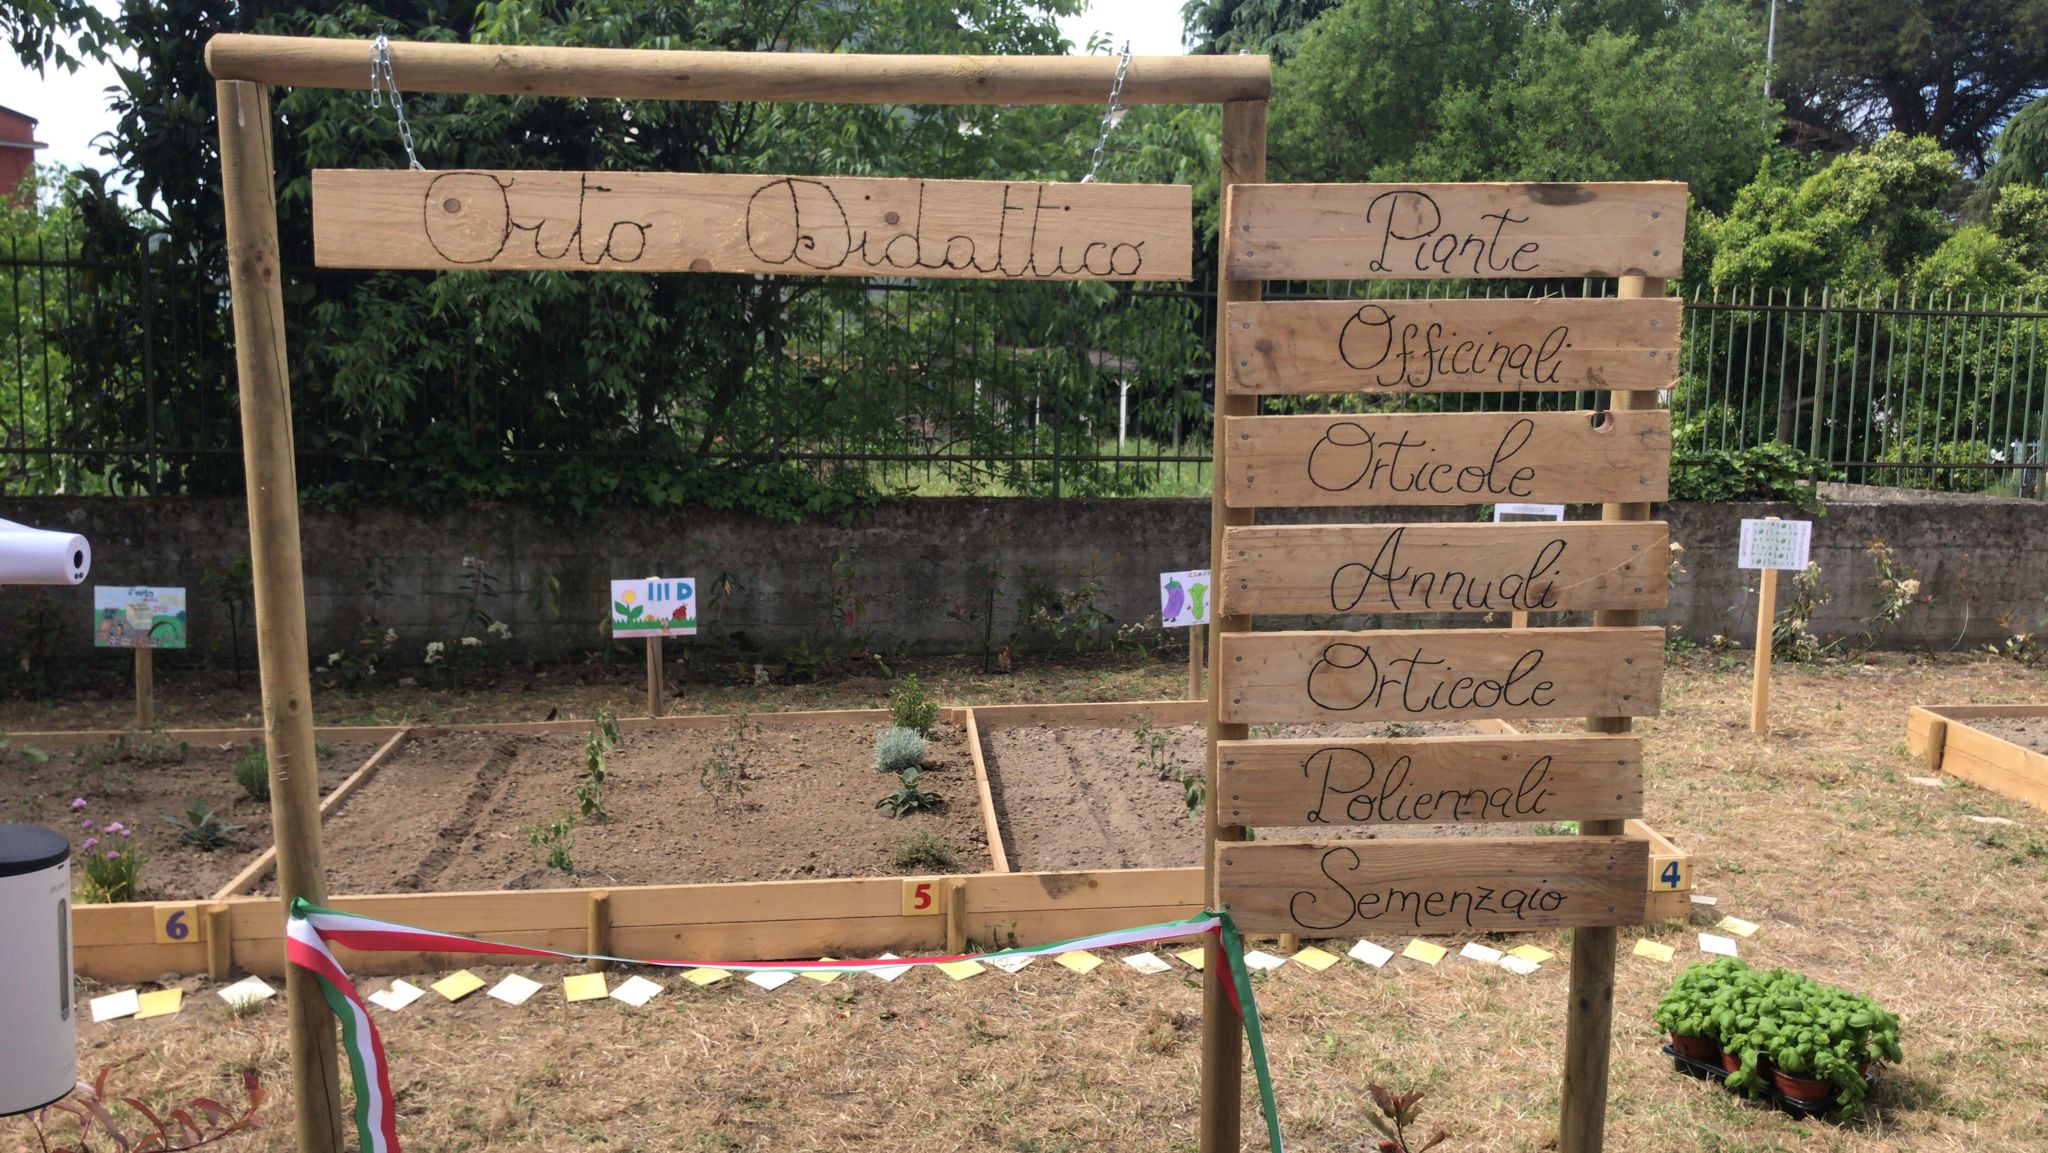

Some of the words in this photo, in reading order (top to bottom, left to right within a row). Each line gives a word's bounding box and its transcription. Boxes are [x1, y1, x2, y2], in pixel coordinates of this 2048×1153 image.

[424, 172, 652, 264] Orto
[746, 178, 1145, 277] Didattico
[1367, 191, 1539, 274] Piante
[1339, 304, 1572, 387] Officinali
[1307, 418, 1536, 497] Orticole
[677, 583, 692, 600] D
[1330, 527, 1567, 611] Annuali
[1307, 642, 1556, 712] Orticole
[1304, 747, 1554, 823] Poliennali
[915, 883, 931, 909] 5
[1289, 847, 1568, 930] Semenzaio
[1661, 861, 1680, 888] 4
[166, 910, 188, 939] 6
